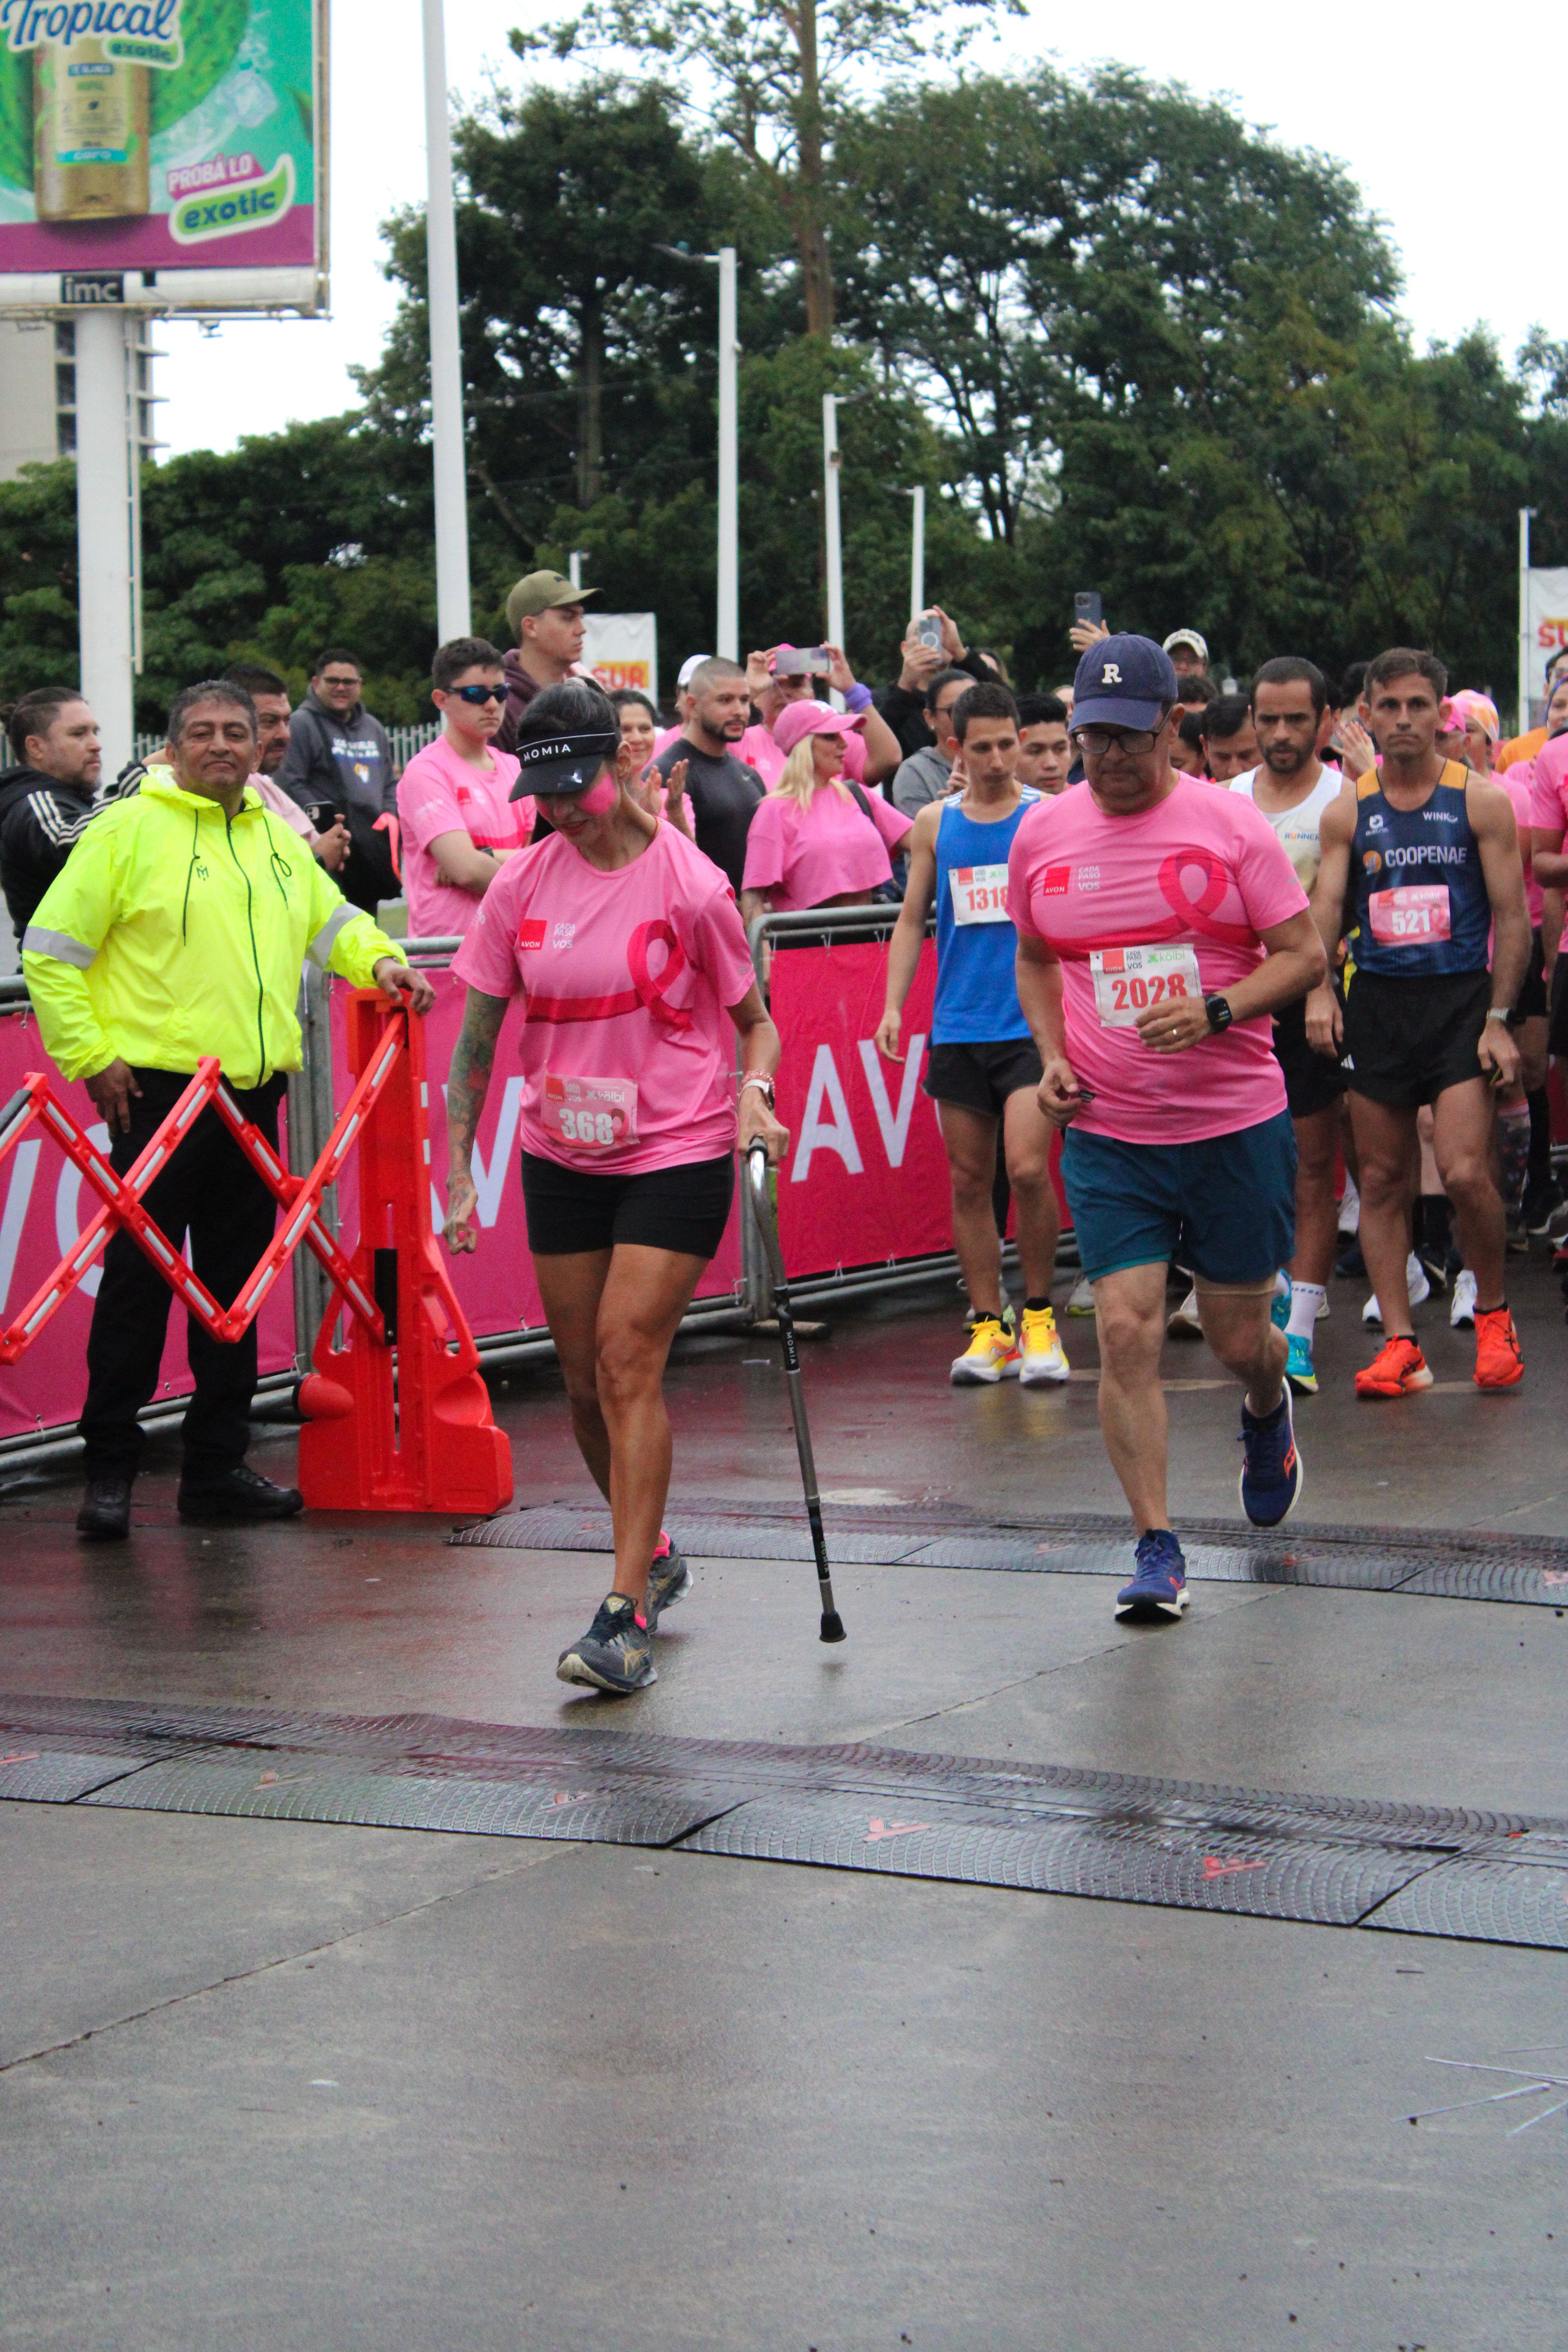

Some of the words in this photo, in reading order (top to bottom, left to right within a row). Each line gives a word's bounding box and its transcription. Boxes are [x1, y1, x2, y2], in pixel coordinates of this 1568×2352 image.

[2, 0, 176, 45] Tropical
[169, 154, 225, 192] PROBÁ
[229, 154, 252, 177] LO
[183, 188, 275, 229] exotic
[66, 277, 117, 301] imc
[1102, 663, 1122, 684] R
[524, 744, 571, 761] MOMIA
[1385, 846, 1467, 867] COOPENAE
[966, 885, 1008, 911] 1318
[1079, 882, 1100, 891] VOS
[1392, 909, 1430, 936] 521
[553, 939, 573, 949] VOS
[1160, 951, 1185, 962] kölbi
[1112, 973, 1187, 1010] 2028
[597, 1091, 624, 1102] kölbi
[791, 1033, 942, 1183] AV
[559, 1108, 614, 1145] 368
[786, 1332, 797, 1365] MOMIA
